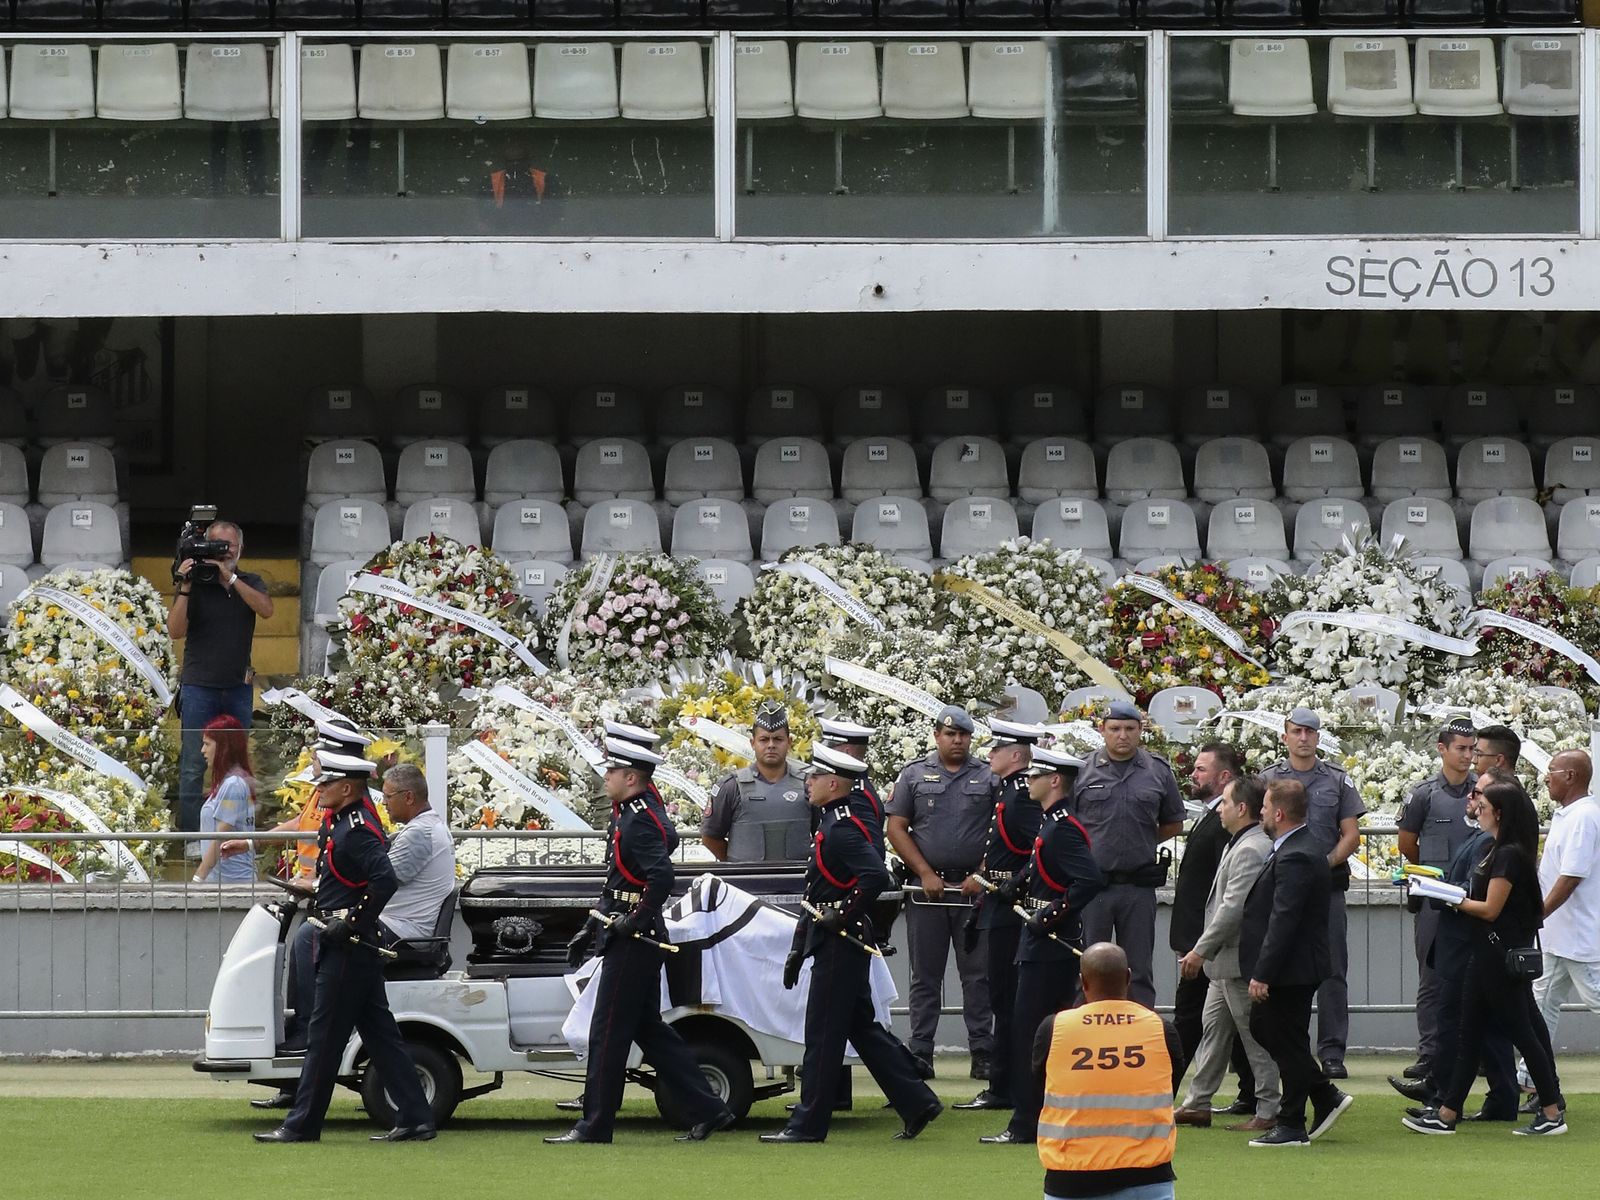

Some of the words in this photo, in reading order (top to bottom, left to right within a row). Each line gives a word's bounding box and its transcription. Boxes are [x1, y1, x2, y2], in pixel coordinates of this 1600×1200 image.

[1326, 249, 1498, 302] SEÇÃO
[1510, 257, 1555, 297] 13
[59, 732, 84, 750] OBRIGADA
[74, 750, 97, 766] SANTISTA
[515, 779, 531, 793] Canal
[531, 790, 549, 805] Brasil
[1082, 1014, 1135, 1025] STAFF
[1071, 1045, 1145, 1070] 255
